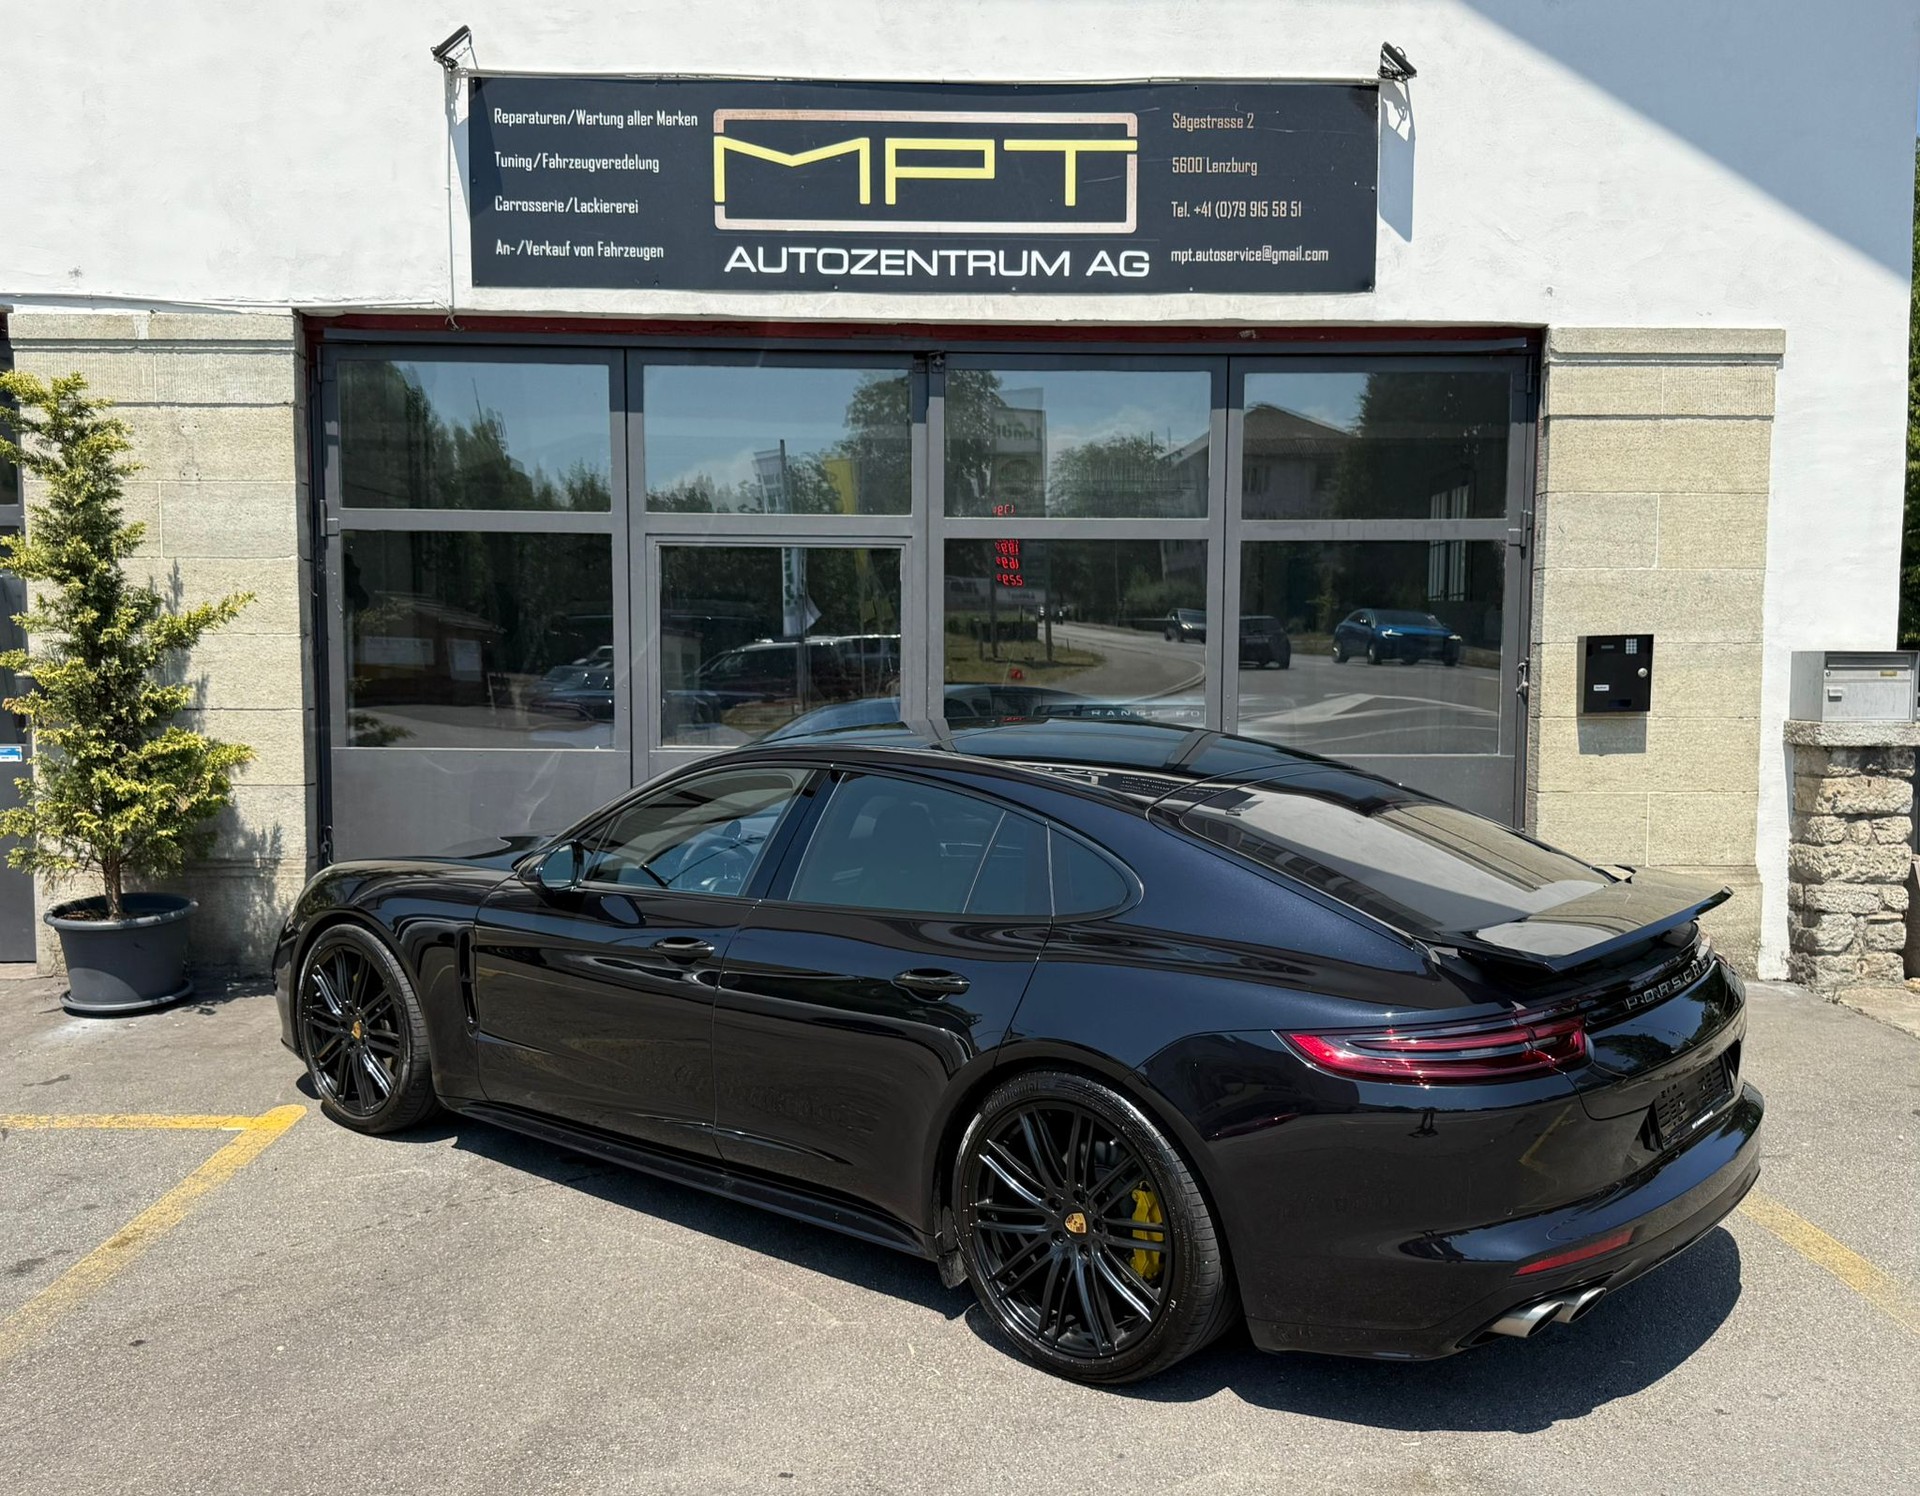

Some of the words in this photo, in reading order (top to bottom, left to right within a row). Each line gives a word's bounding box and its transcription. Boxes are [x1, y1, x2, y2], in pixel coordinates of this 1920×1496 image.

[494, 108, 624, 128] Reparaturen/Wartung
[627, 111, 653, 126] aller
[657, 111, 698, 127] Marken
[1172, 112, 1243, 132] Sägestrasse
[1247, 113, 1254, 129] 2
[494, 151, 660, 173] Tuning/Fahrzeugveredelung
[713, 135, 1138, 206] MPT
[1172, 157, 1203, 173] 5600
[1206, 157, 1258, 176] Lenzburg
[495, 195, 639, 214] Carrosserie/Lackiererei
[1171, 201, 1190, 217] Tel.
[1194, 201, 1211, 217] +41
[1215, 201, 1246, 219] (0)79
[1250, 201, 1268, 217] 915
[1272, 201, 1287, 217] 58
[1291, 201, 1302, 217] 51
[495, 239, 570, 258] An-/Verkauf
[574, 246, 594, 258] von
[598, 241, 664, 261] Fahrzeugen
[1171, 245, 1329, 265] mpt.autoservice@gmail.com
[724, 247, 1070, 277] AUTOZENTRUM
[1086, 250, 1150, 278] AG
